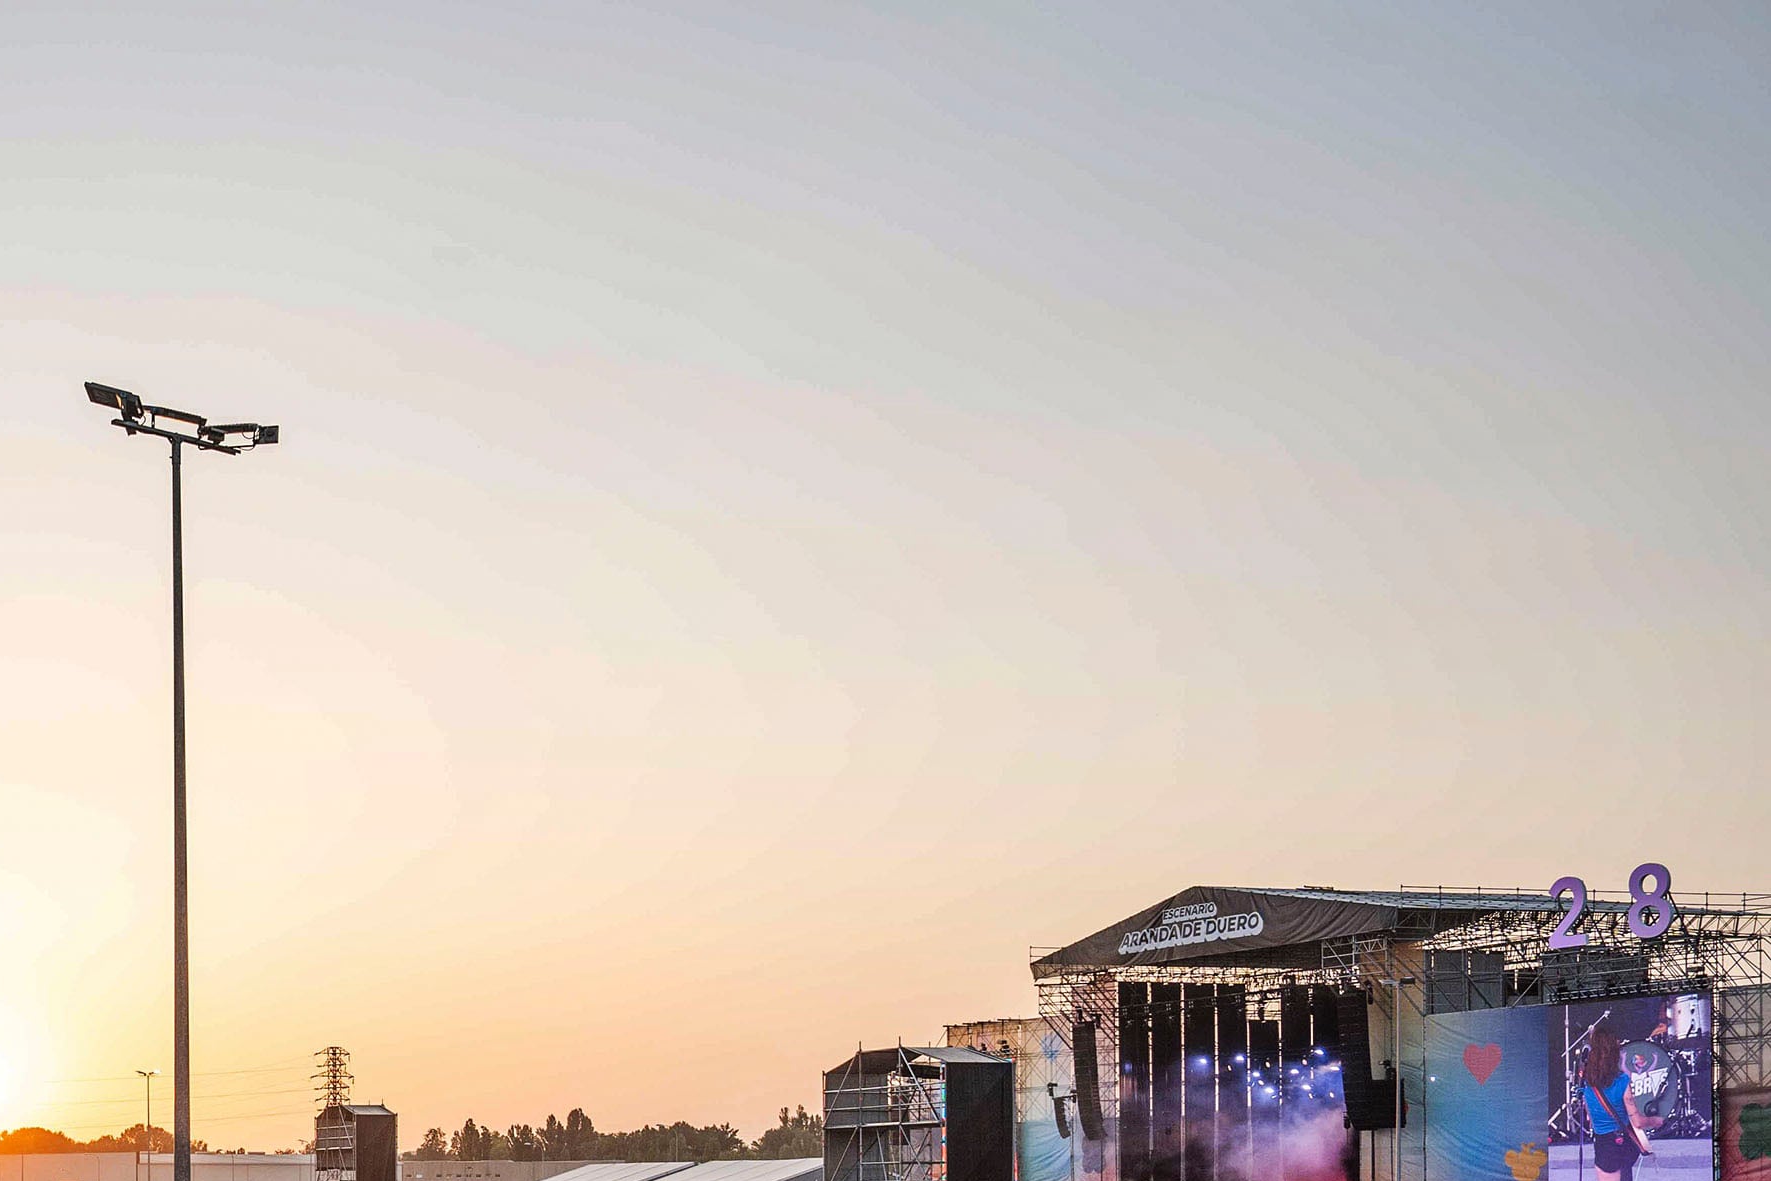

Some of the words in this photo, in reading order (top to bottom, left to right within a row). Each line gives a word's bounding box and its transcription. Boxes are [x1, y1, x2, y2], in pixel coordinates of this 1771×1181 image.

[1162, 902, 1216, 920] ESCENARIO
[1121, 926, 1178, 949] ARANDA
[1182, 921, 1202, 939] DE
[1205, 913, 1260, 936] DUERO
